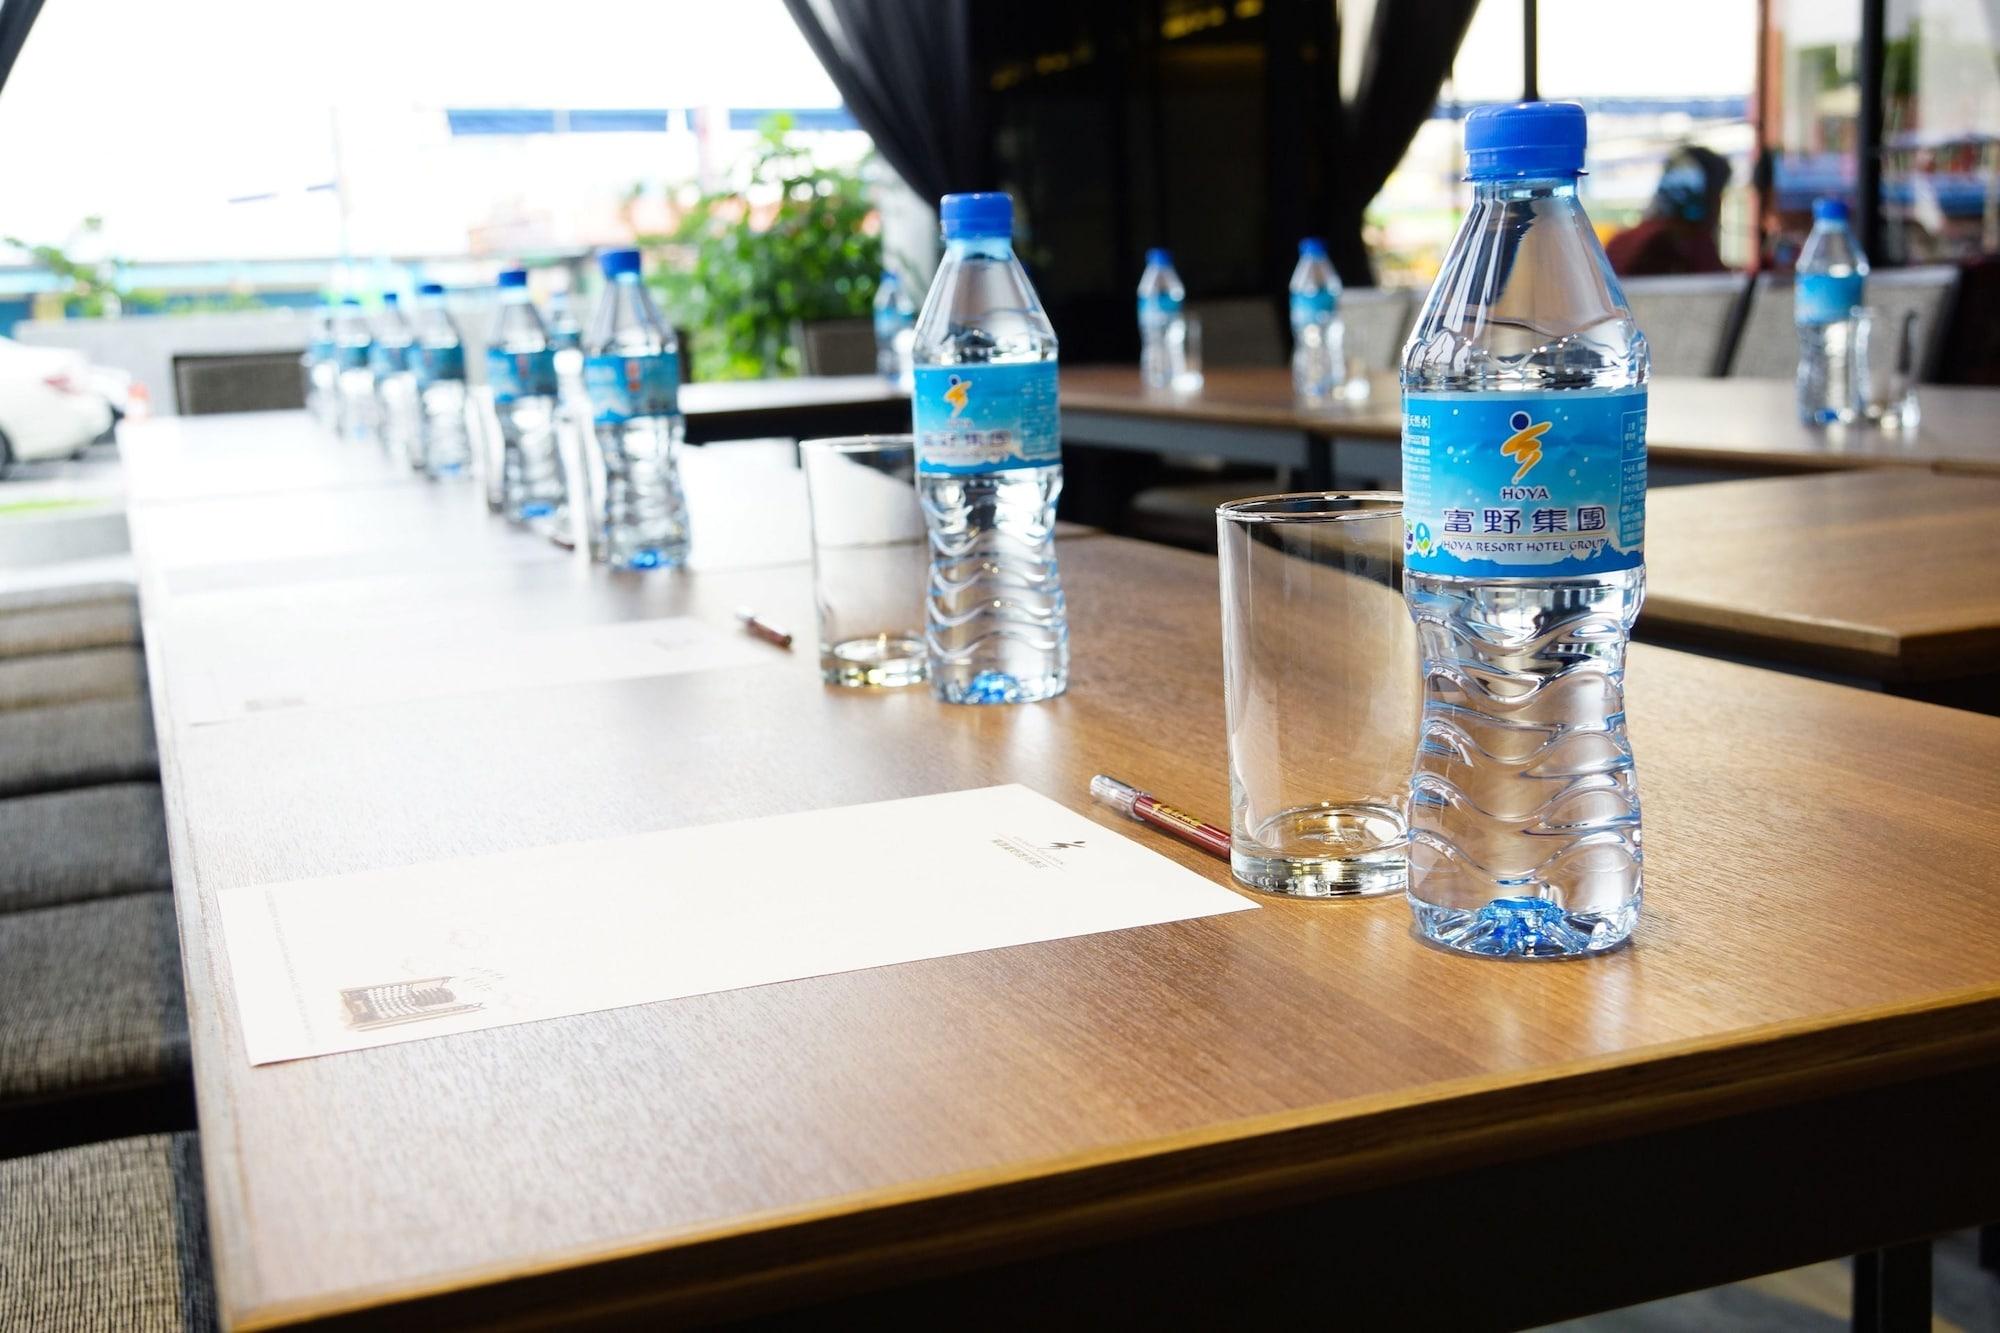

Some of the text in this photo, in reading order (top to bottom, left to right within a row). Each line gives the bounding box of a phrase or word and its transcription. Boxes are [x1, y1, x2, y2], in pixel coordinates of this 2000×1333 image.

[1502, 488, 1549, 500] HOYA
[1443, 506, 1606, 534] 富野集團
[1443, 538, 1608, 552] HOYA RESORT HOTEL GROUP
